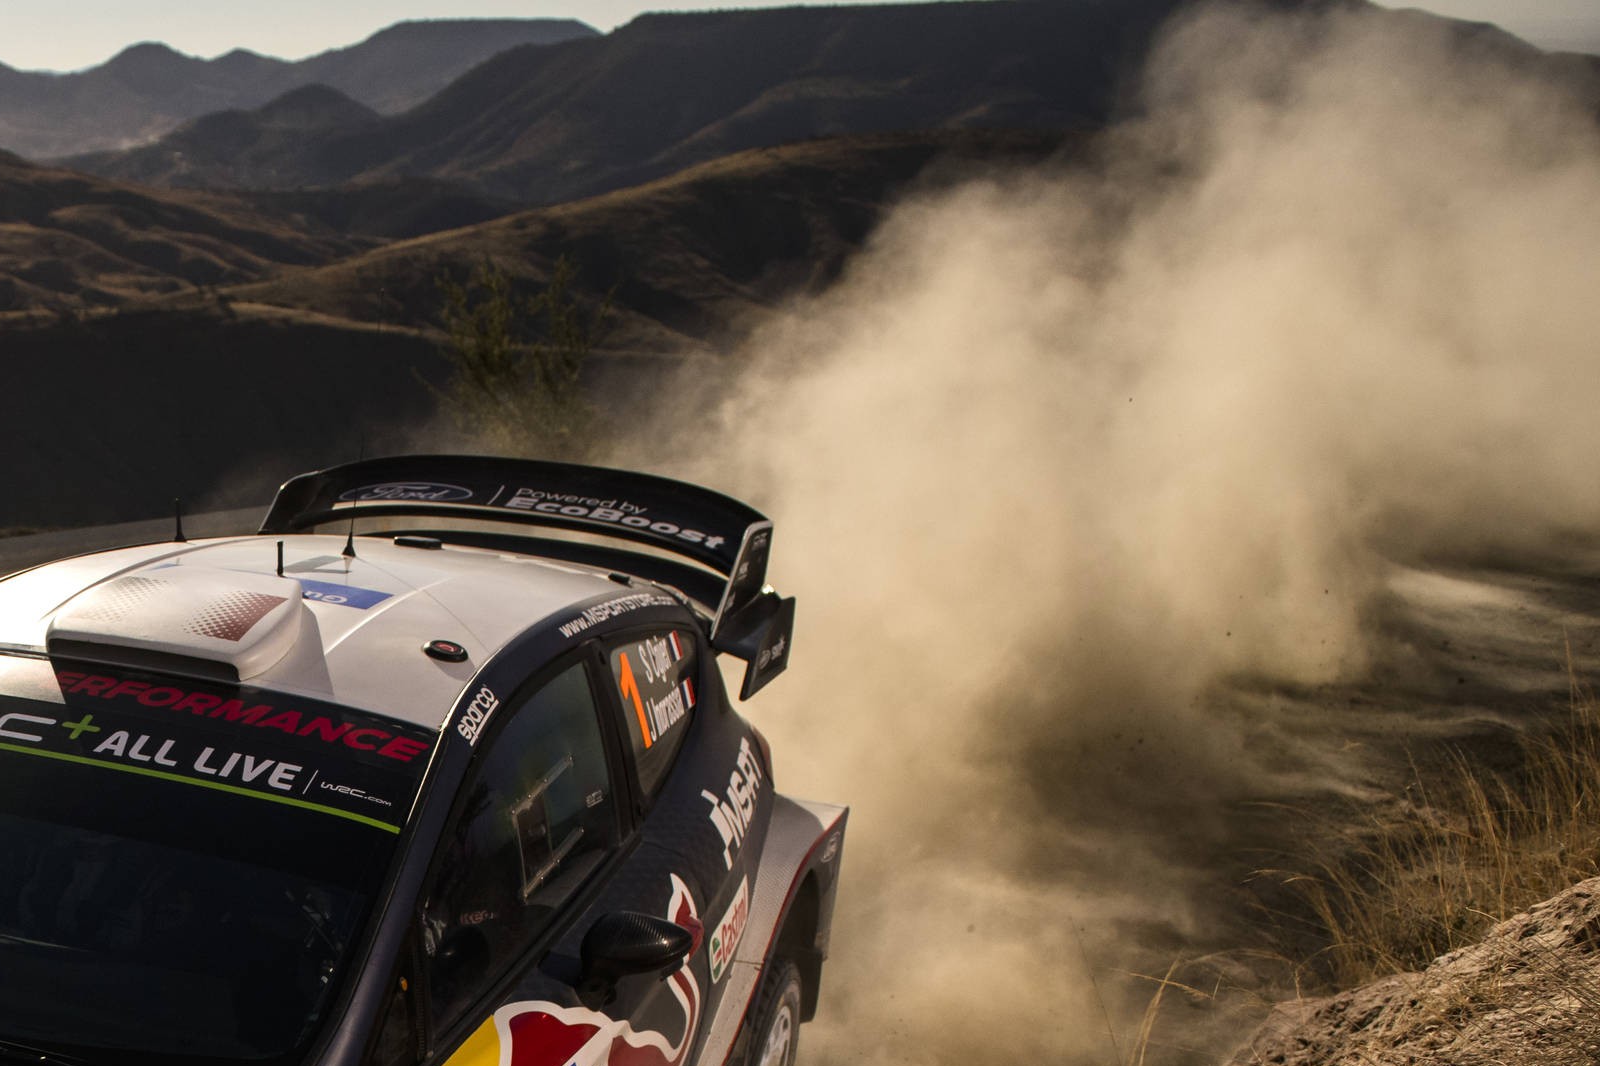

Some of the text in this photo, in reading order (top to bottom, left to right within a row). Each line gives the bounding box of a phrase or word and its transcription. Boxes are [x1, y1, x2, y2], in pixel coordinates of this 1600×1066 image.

[360, 485, 450, 500] Ford
[516, 487, 649, 516] Powered by
[506, 496, 727, 549] EcoBoost
[457, 685, 496, 741] sparco
[619, 651, 653, 749] 1
[94, 730, 179, 768] ALL
[197, 746, 304, 791] LIVE
